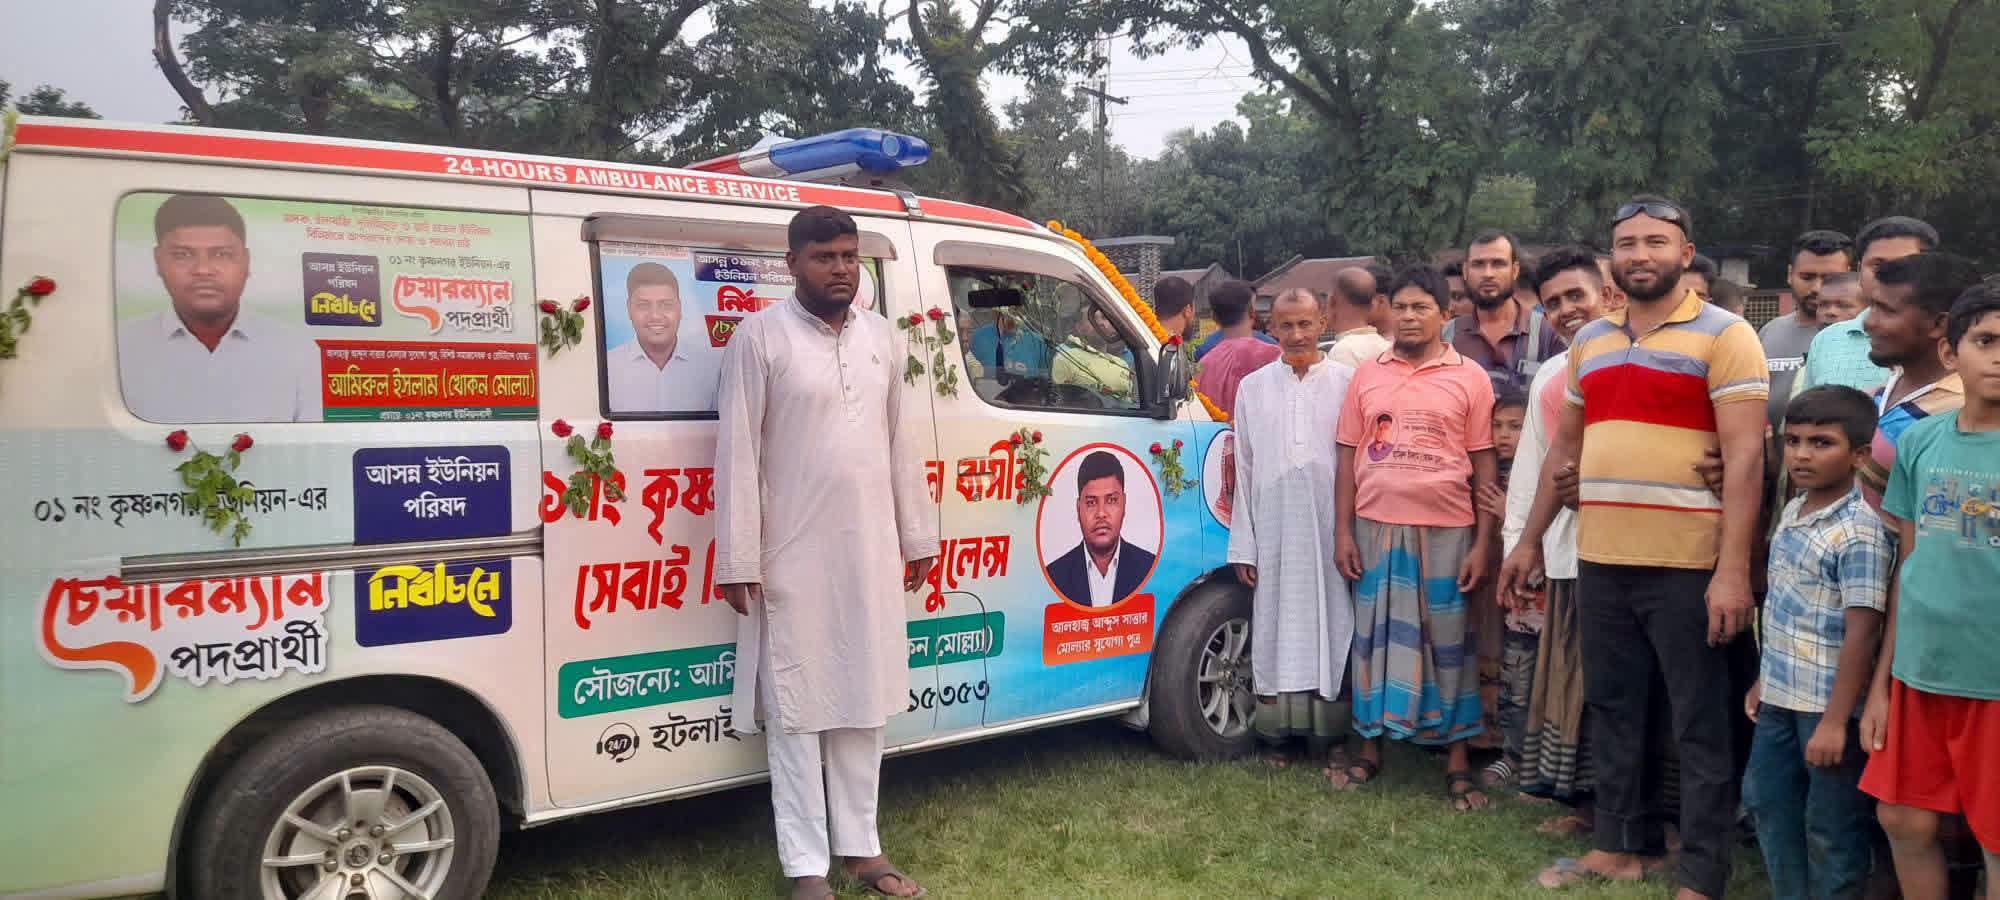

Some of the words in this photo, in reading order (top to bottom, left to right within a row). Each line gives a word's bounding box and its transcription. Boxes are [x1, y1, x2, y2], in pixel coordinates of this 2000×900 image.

[447, 155, 569, 184] 24-HOURS
[574, 169, 710, 196] AMBULANCE
[715, 180, 799, 202] SERVICE
[311, 292, 377, 322] নির্বাচনে
[393, 275, 510, 330] চেয়ারম্যান
[446, 306, 511, 329] পদপ্রার্থী
[328, 364, 389, 397] আমিরুল
[393, 367, 438, 398] ইসলাম
[442, 368, 488, 399] (খোকন
[364, 463, 422, 485] আসন্ন
[425, 455, 501, 485] ইউনিয়ন
[34, 497, 67, 523] ০১
[72, 494, 104, 521] নং
[403, 490, 467, 519] পরিষদ
[367, 561, 502, 617] নির্বাচনে
[574, 543, 691, 630] সেবাই
[42, 570, 325, 695] চেয়ারম্যান
[170, 618, 323, 678] পদপ্রার্থী
[573, 663, 681, 705] সৌজন্যে:
[607, 737, 629, 752] 24/7
